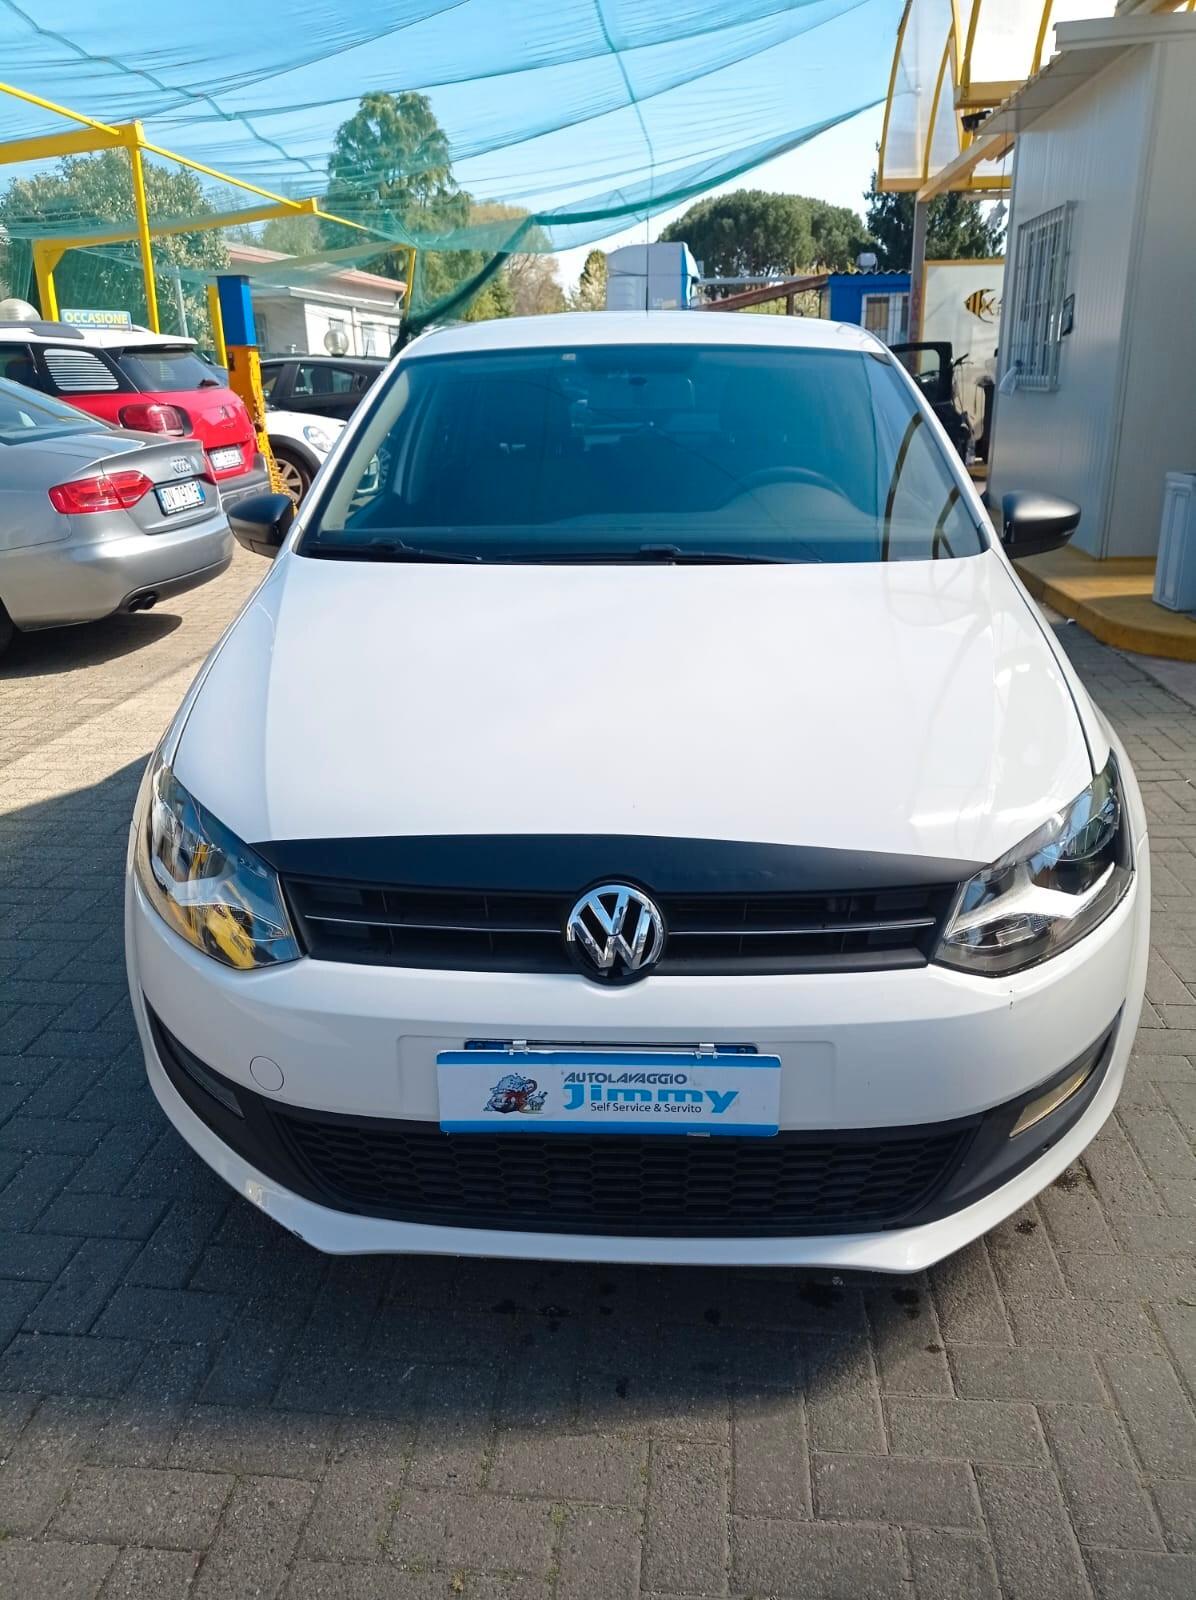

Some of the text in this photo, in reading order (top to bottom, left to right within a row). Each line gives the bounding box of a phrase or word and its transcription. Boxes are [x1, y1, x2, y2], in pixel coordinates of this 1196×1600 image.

[64, 311, 129, 325] OCCASIONE
[564, 1071, 688, 1085] AUTOLAVAGGIO
[563, 1083, 739, 1114] Jimmy
[590, 1102, 702, 1113] Self Service & Servito
